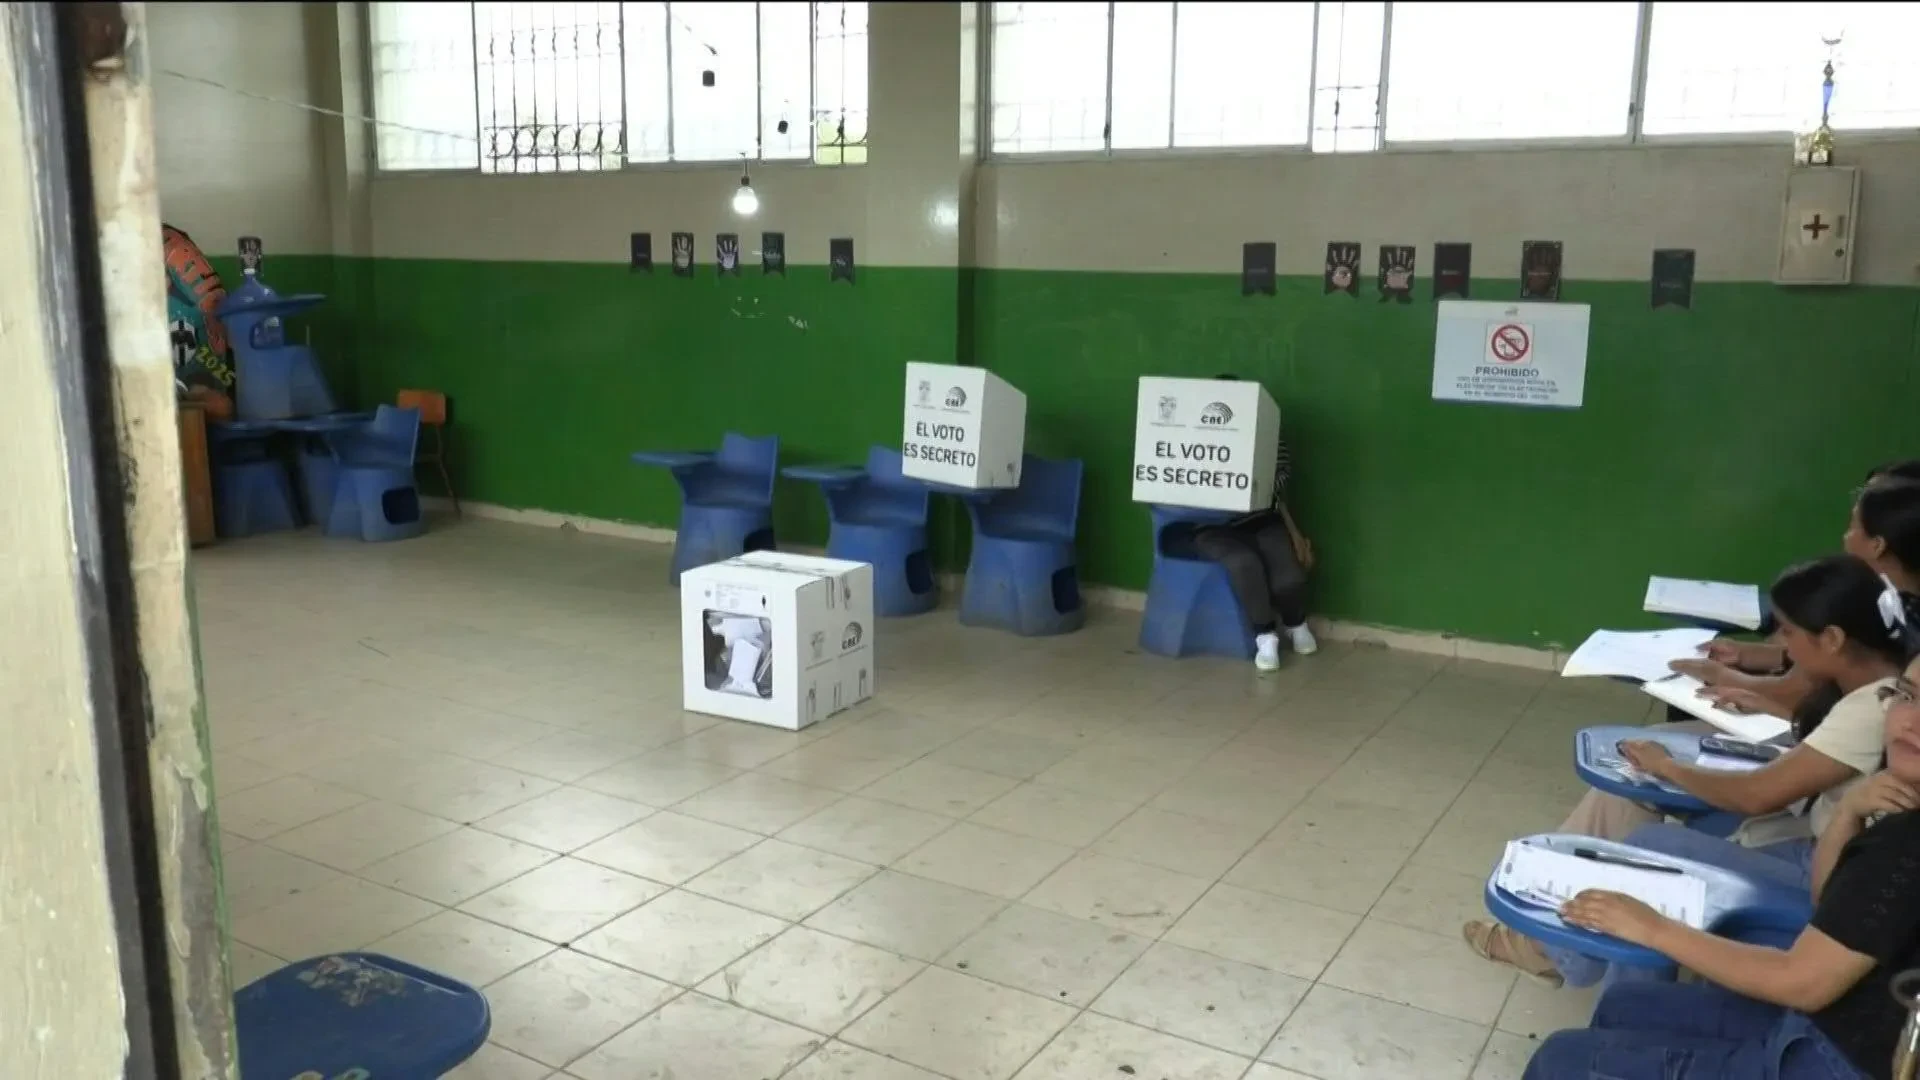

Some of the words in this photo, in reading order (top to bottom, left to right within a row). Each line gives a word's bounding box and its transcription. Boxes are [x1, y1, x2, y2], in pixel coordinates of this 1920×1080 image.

[195, 345, 236, 386] 2025
[1475, 366, 1539, 377] PROHIBIDO
[916, 421, 929, 437] EL
[932, 423, 965, 442] VOTO
[904, 442, 918, 458] ES
[920, 444, 976, 467] SECRETO
[1155, 440, 1176, 458] EL
[1180, 442, 1231, 463] VOTO
[1135, 464, 1158, 481] ES
[1163, 466, 1249, 490] SECRETO
